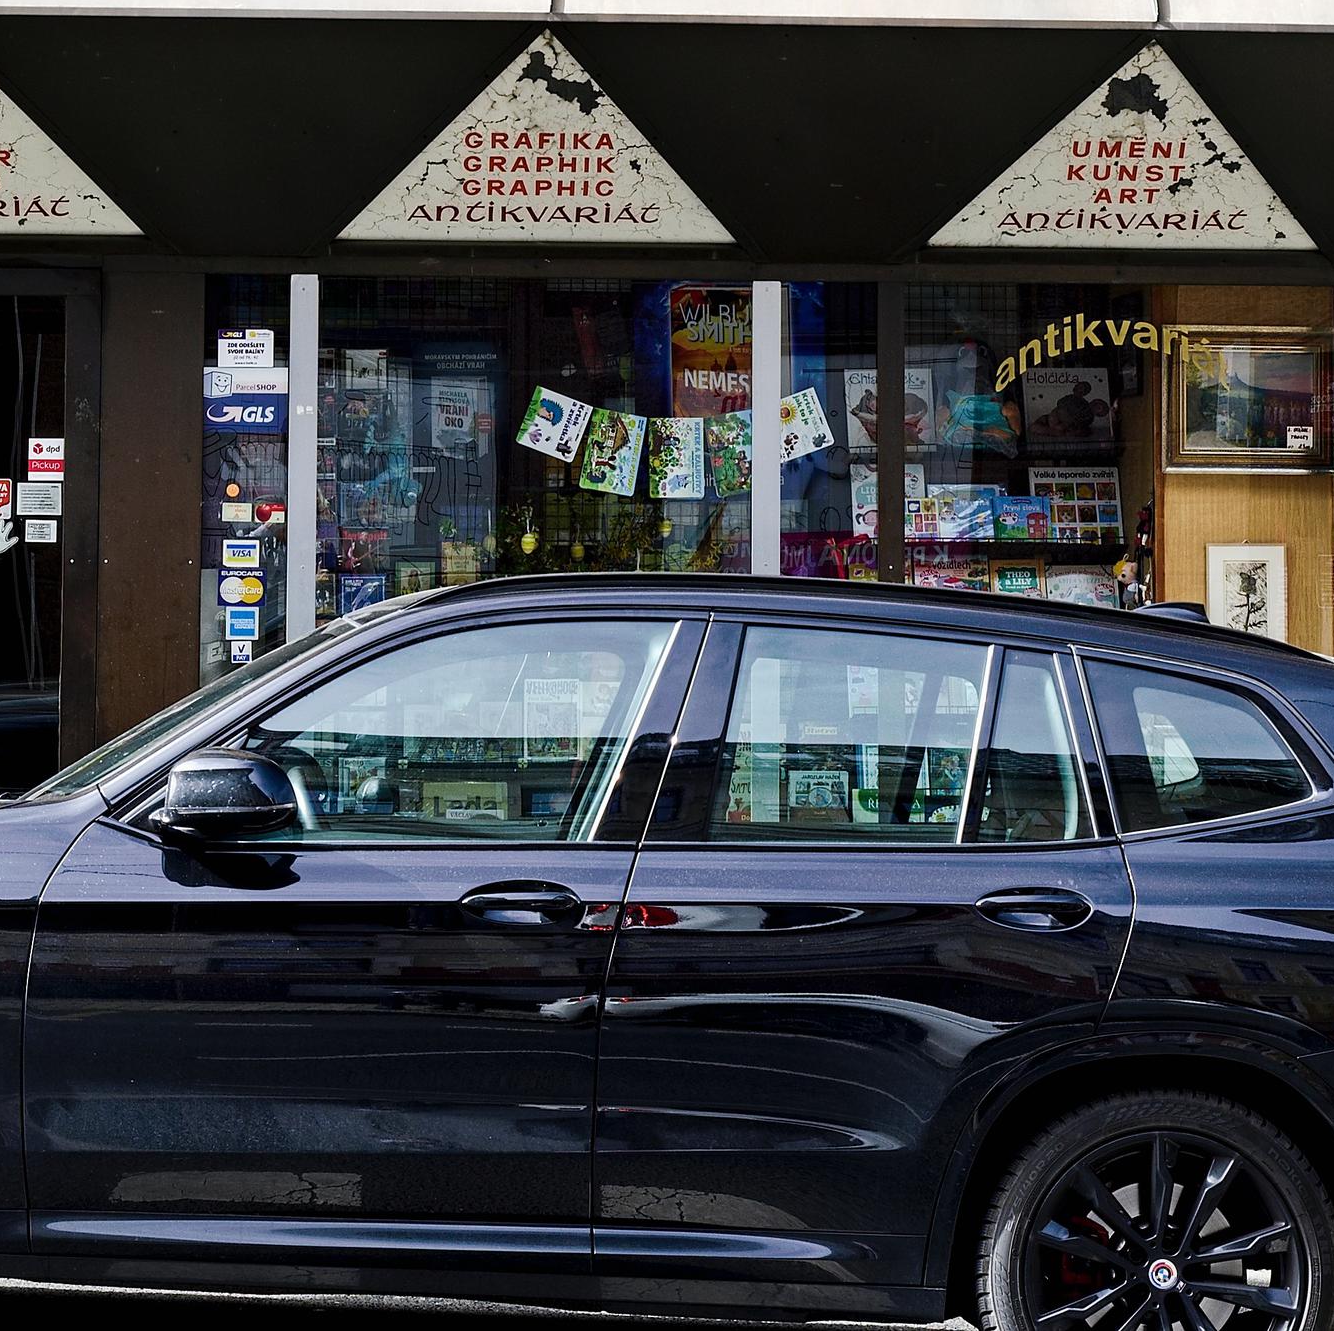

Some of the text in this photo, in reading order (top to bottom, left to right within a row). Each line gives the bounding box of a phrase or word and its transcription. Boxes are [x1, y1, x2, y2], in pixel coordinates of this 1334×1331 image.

[465, 132, 615, 151] GRAFIKA
[463, 155, 615, 174] GRAPHIK
[1067, 163, 1187, 182] KUNST
[463, 178, 615, 197] GRAPHIC
[1094, 187, 1157, 206] ART
[995, 312, 1231, 393] antikvariát
[684, 368, 751, 395] NEMES
[242, 406, 275, 423] GLS
[444, 417, 464, 429] OKO
[31, 461, 61, 470] Pickup
[232, 549, 252, 558] VISA
[1005, 571, 1030, 579] THEO
